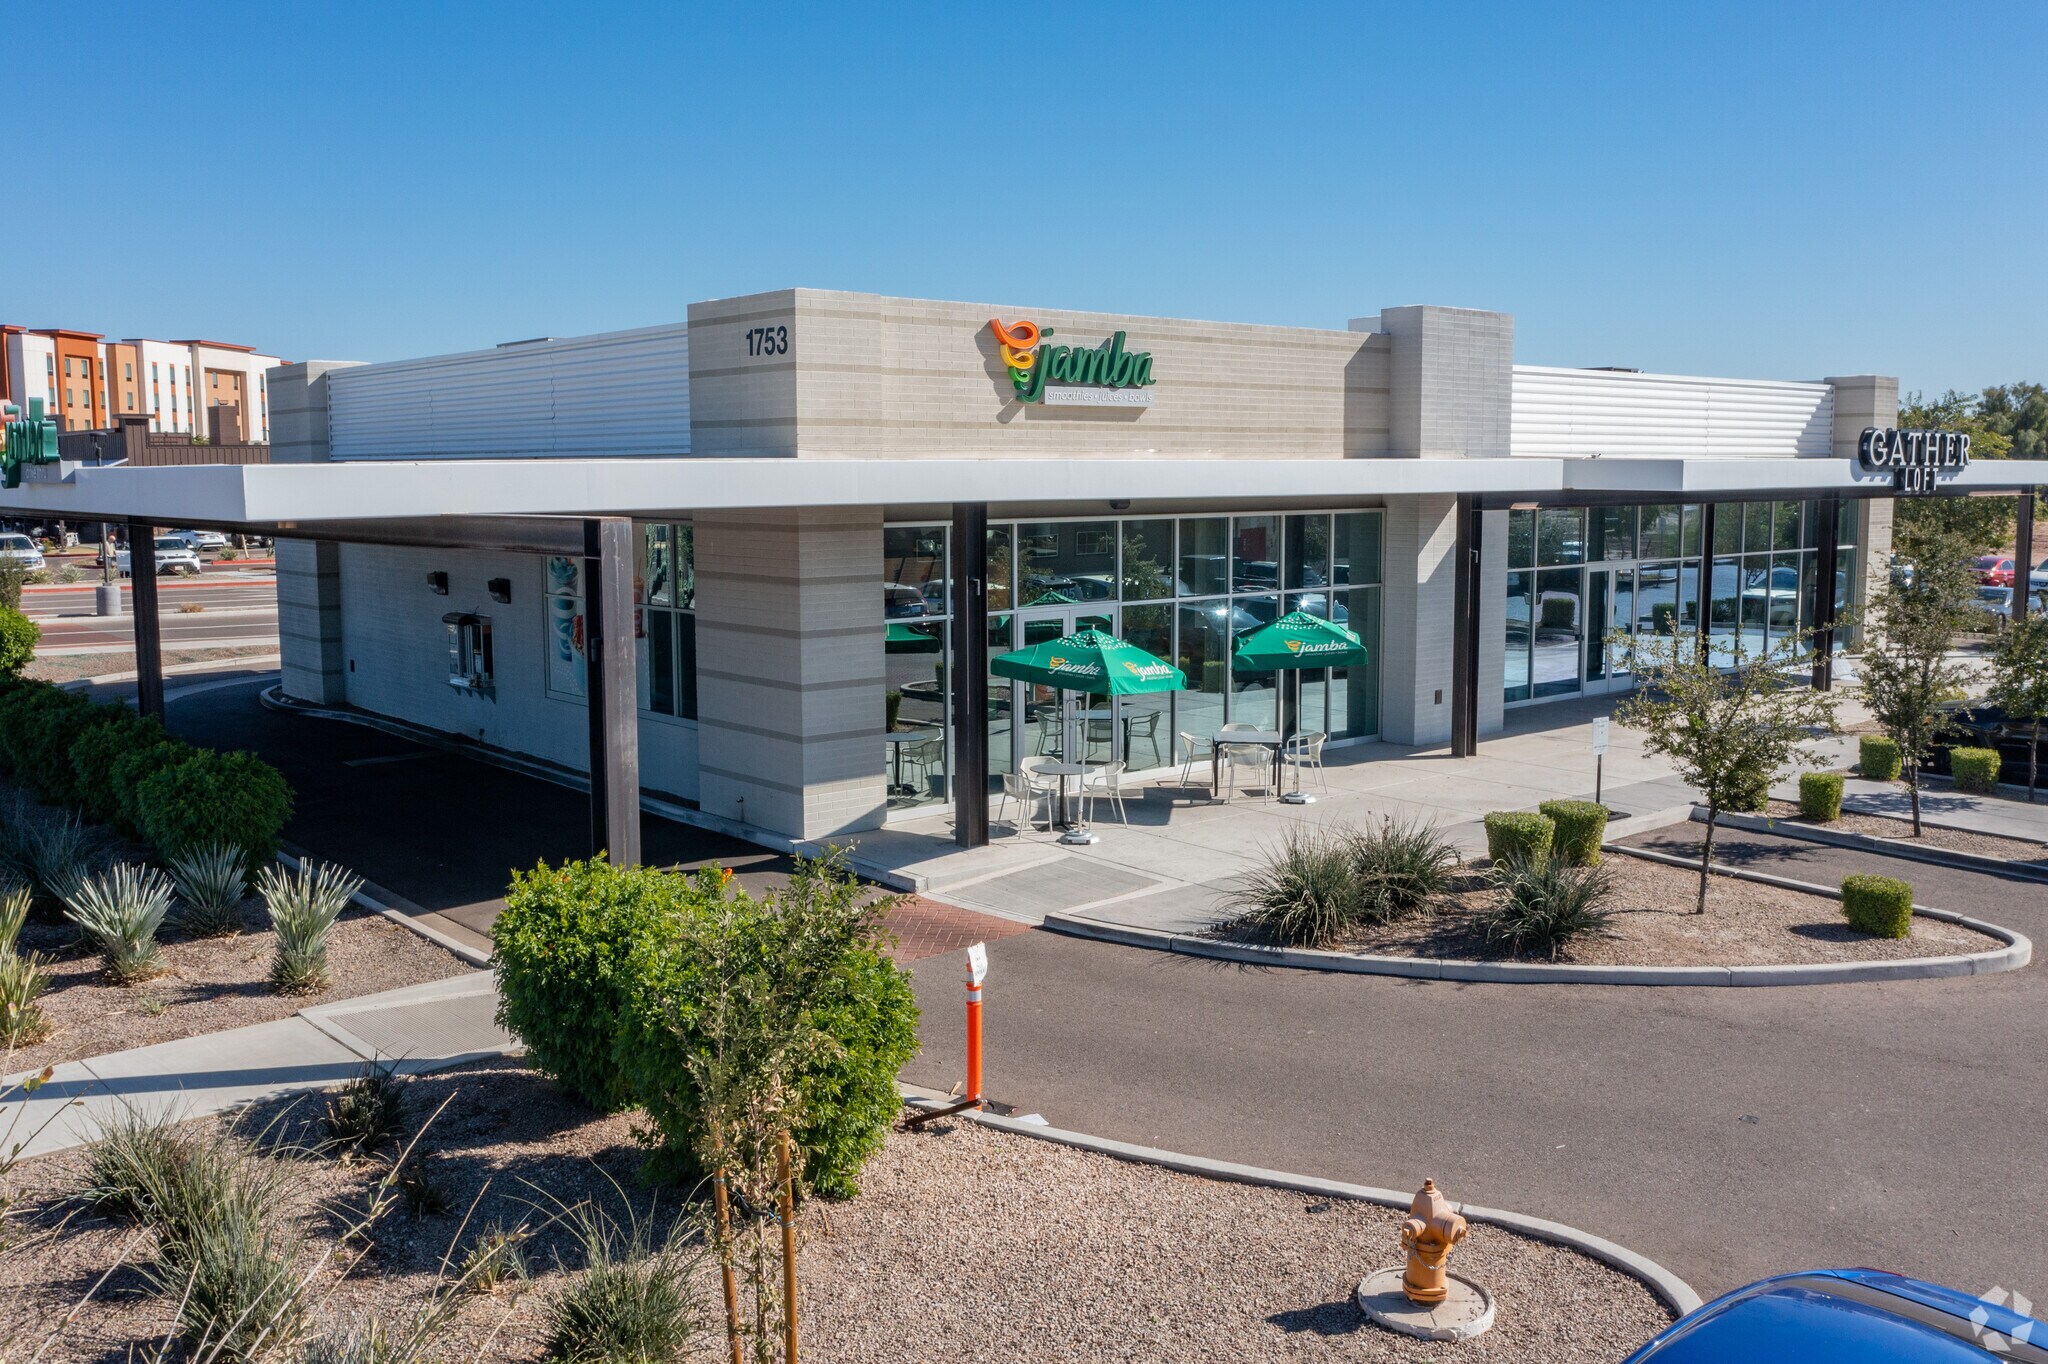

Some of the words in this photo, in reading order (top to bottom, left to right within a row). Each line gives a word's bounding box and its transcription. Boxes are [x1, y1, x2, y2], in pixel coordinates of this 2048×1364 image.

[745, 325, 788, 356] 1753
[1016, 327, 1157, 404] jamba
[1048, 389, 1093, 401] smoothies
[1097, 390, 1123, 404] juices
[1128, 391, 1153, 403] bowls
[1869, 429, 1971, 467] GATHER
[1904, 467, 1939, 491] LOFT
[1293, 639, 1349, 658] jamba
[1047, 660, 1101, 676] jamba
[1134, 660, 1173, 682] jamba
